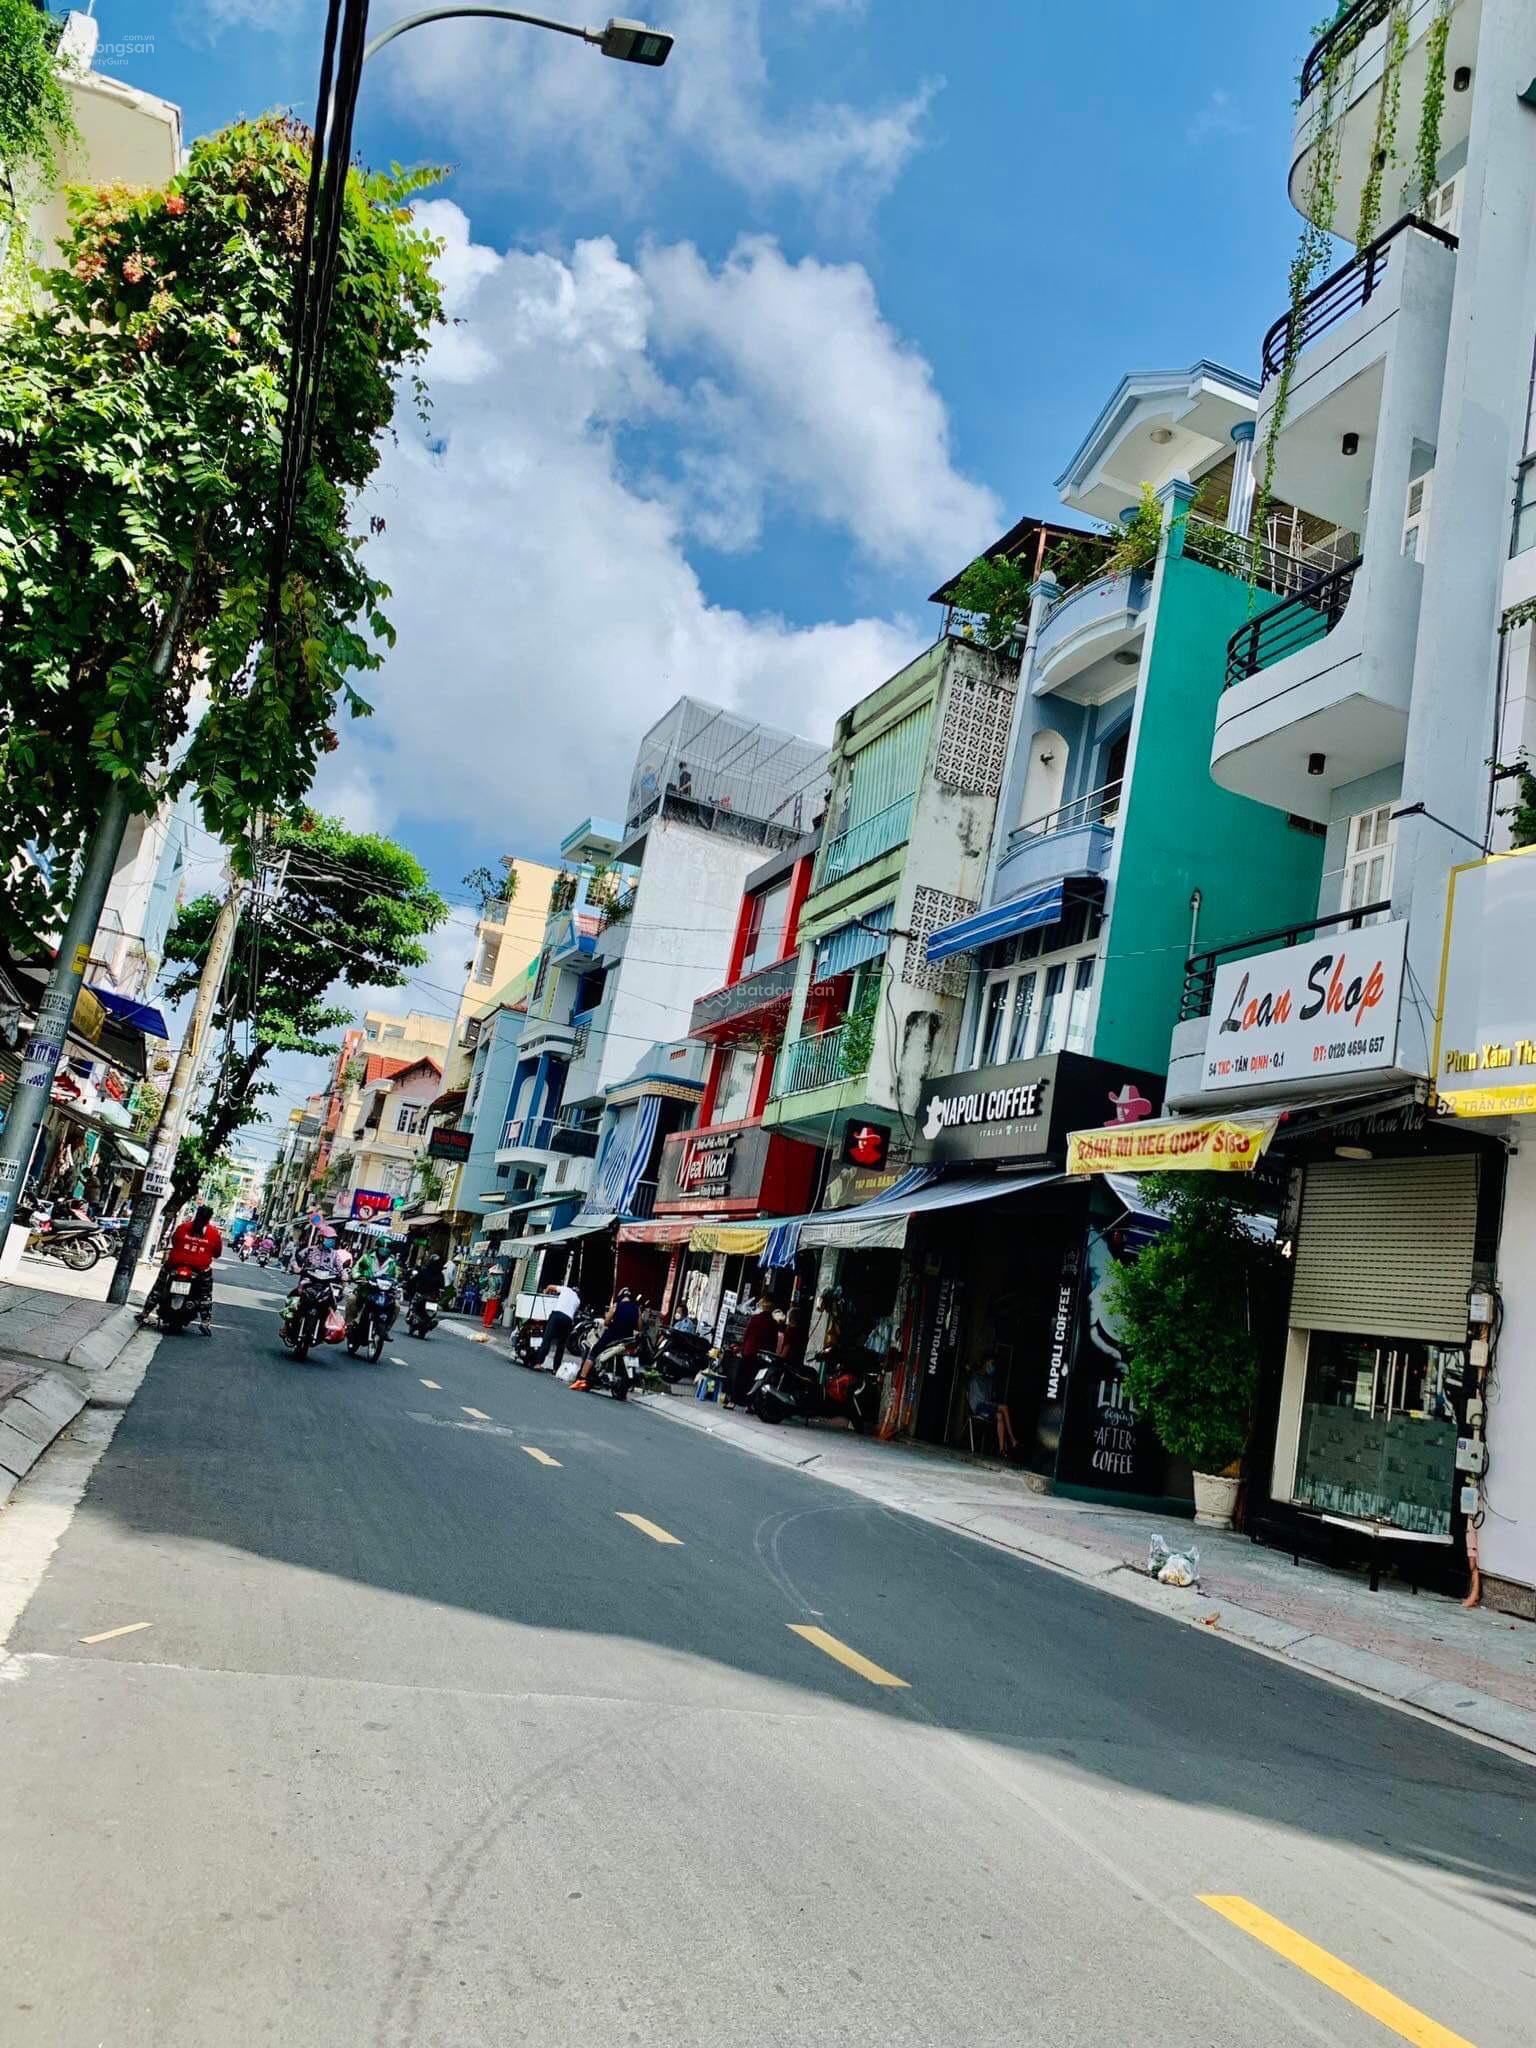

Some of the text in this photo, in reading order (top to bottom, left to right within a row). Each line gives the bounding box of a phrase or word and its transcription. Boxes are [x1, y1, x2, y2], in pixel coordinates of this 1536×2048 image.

[1300, 953, 1384, 1027] Shop
[1369, 1036, 1385, 1053] 657
[1445, 1050, 1478, 1074] Phun
[942, 1084, 1038, 1126] NAPOLI COFFEE
[1436, 1096, 1457, 1115] 52
[1015, 1123, 1038, 1134] STYLE
[1047, 1345, 1063, 1399] NAPOLI
[1055, 1286, 1071, 1342] COFFEE
[1096, 1426, 1132, 1450] AFTER
[1092, 1449, 1133, 1474] COFFEE
